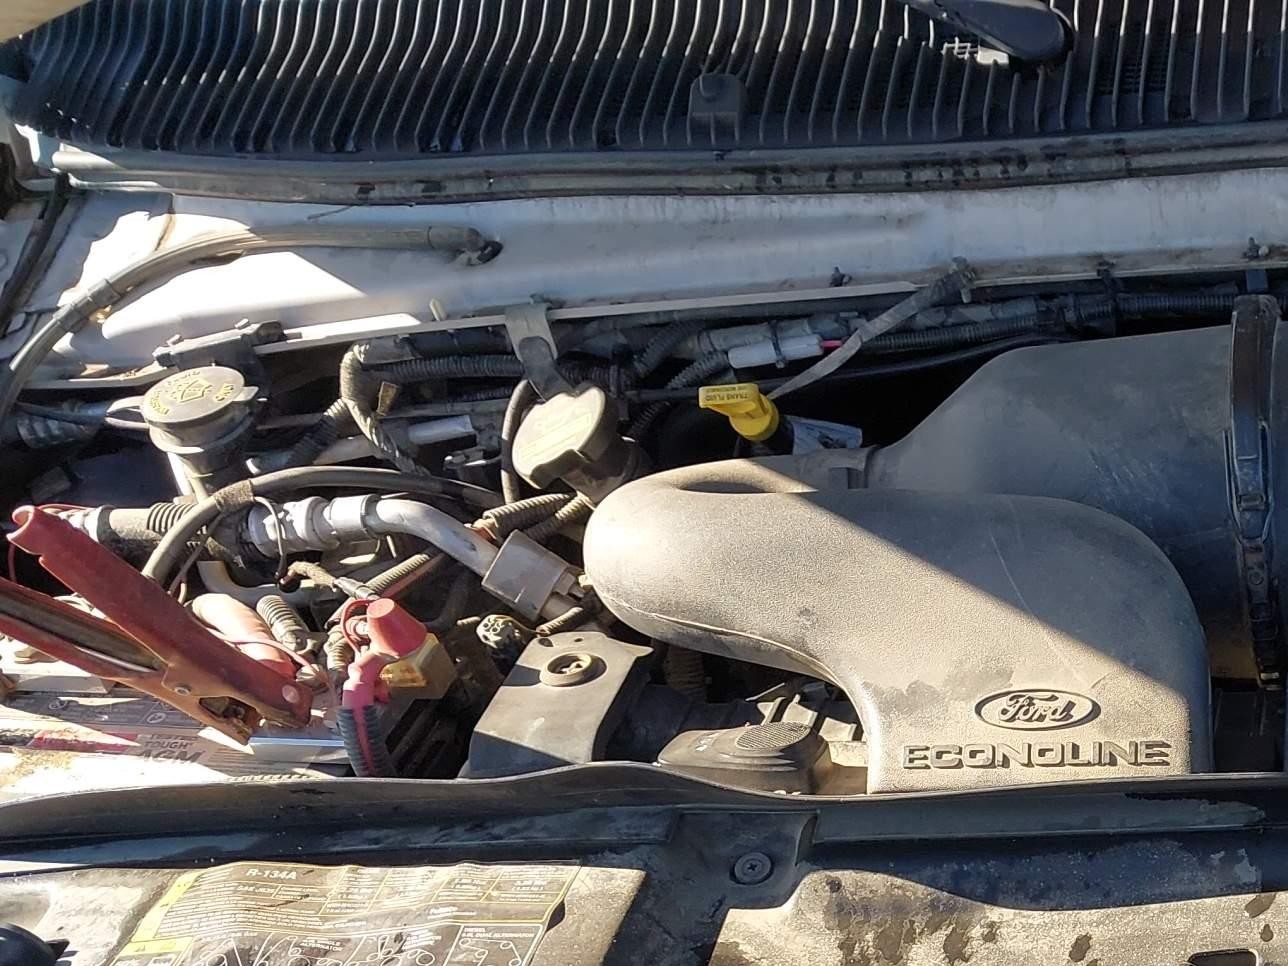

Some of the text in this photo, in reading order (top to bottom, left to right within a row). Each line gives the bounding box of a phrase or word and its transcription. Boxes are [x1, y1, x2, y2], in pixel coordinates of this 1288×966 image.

[999, 693, 1074, 723] Ford
[903, 741, 1172, 770] ECONOLINE
[246, 868, 297, 880] R-134A
